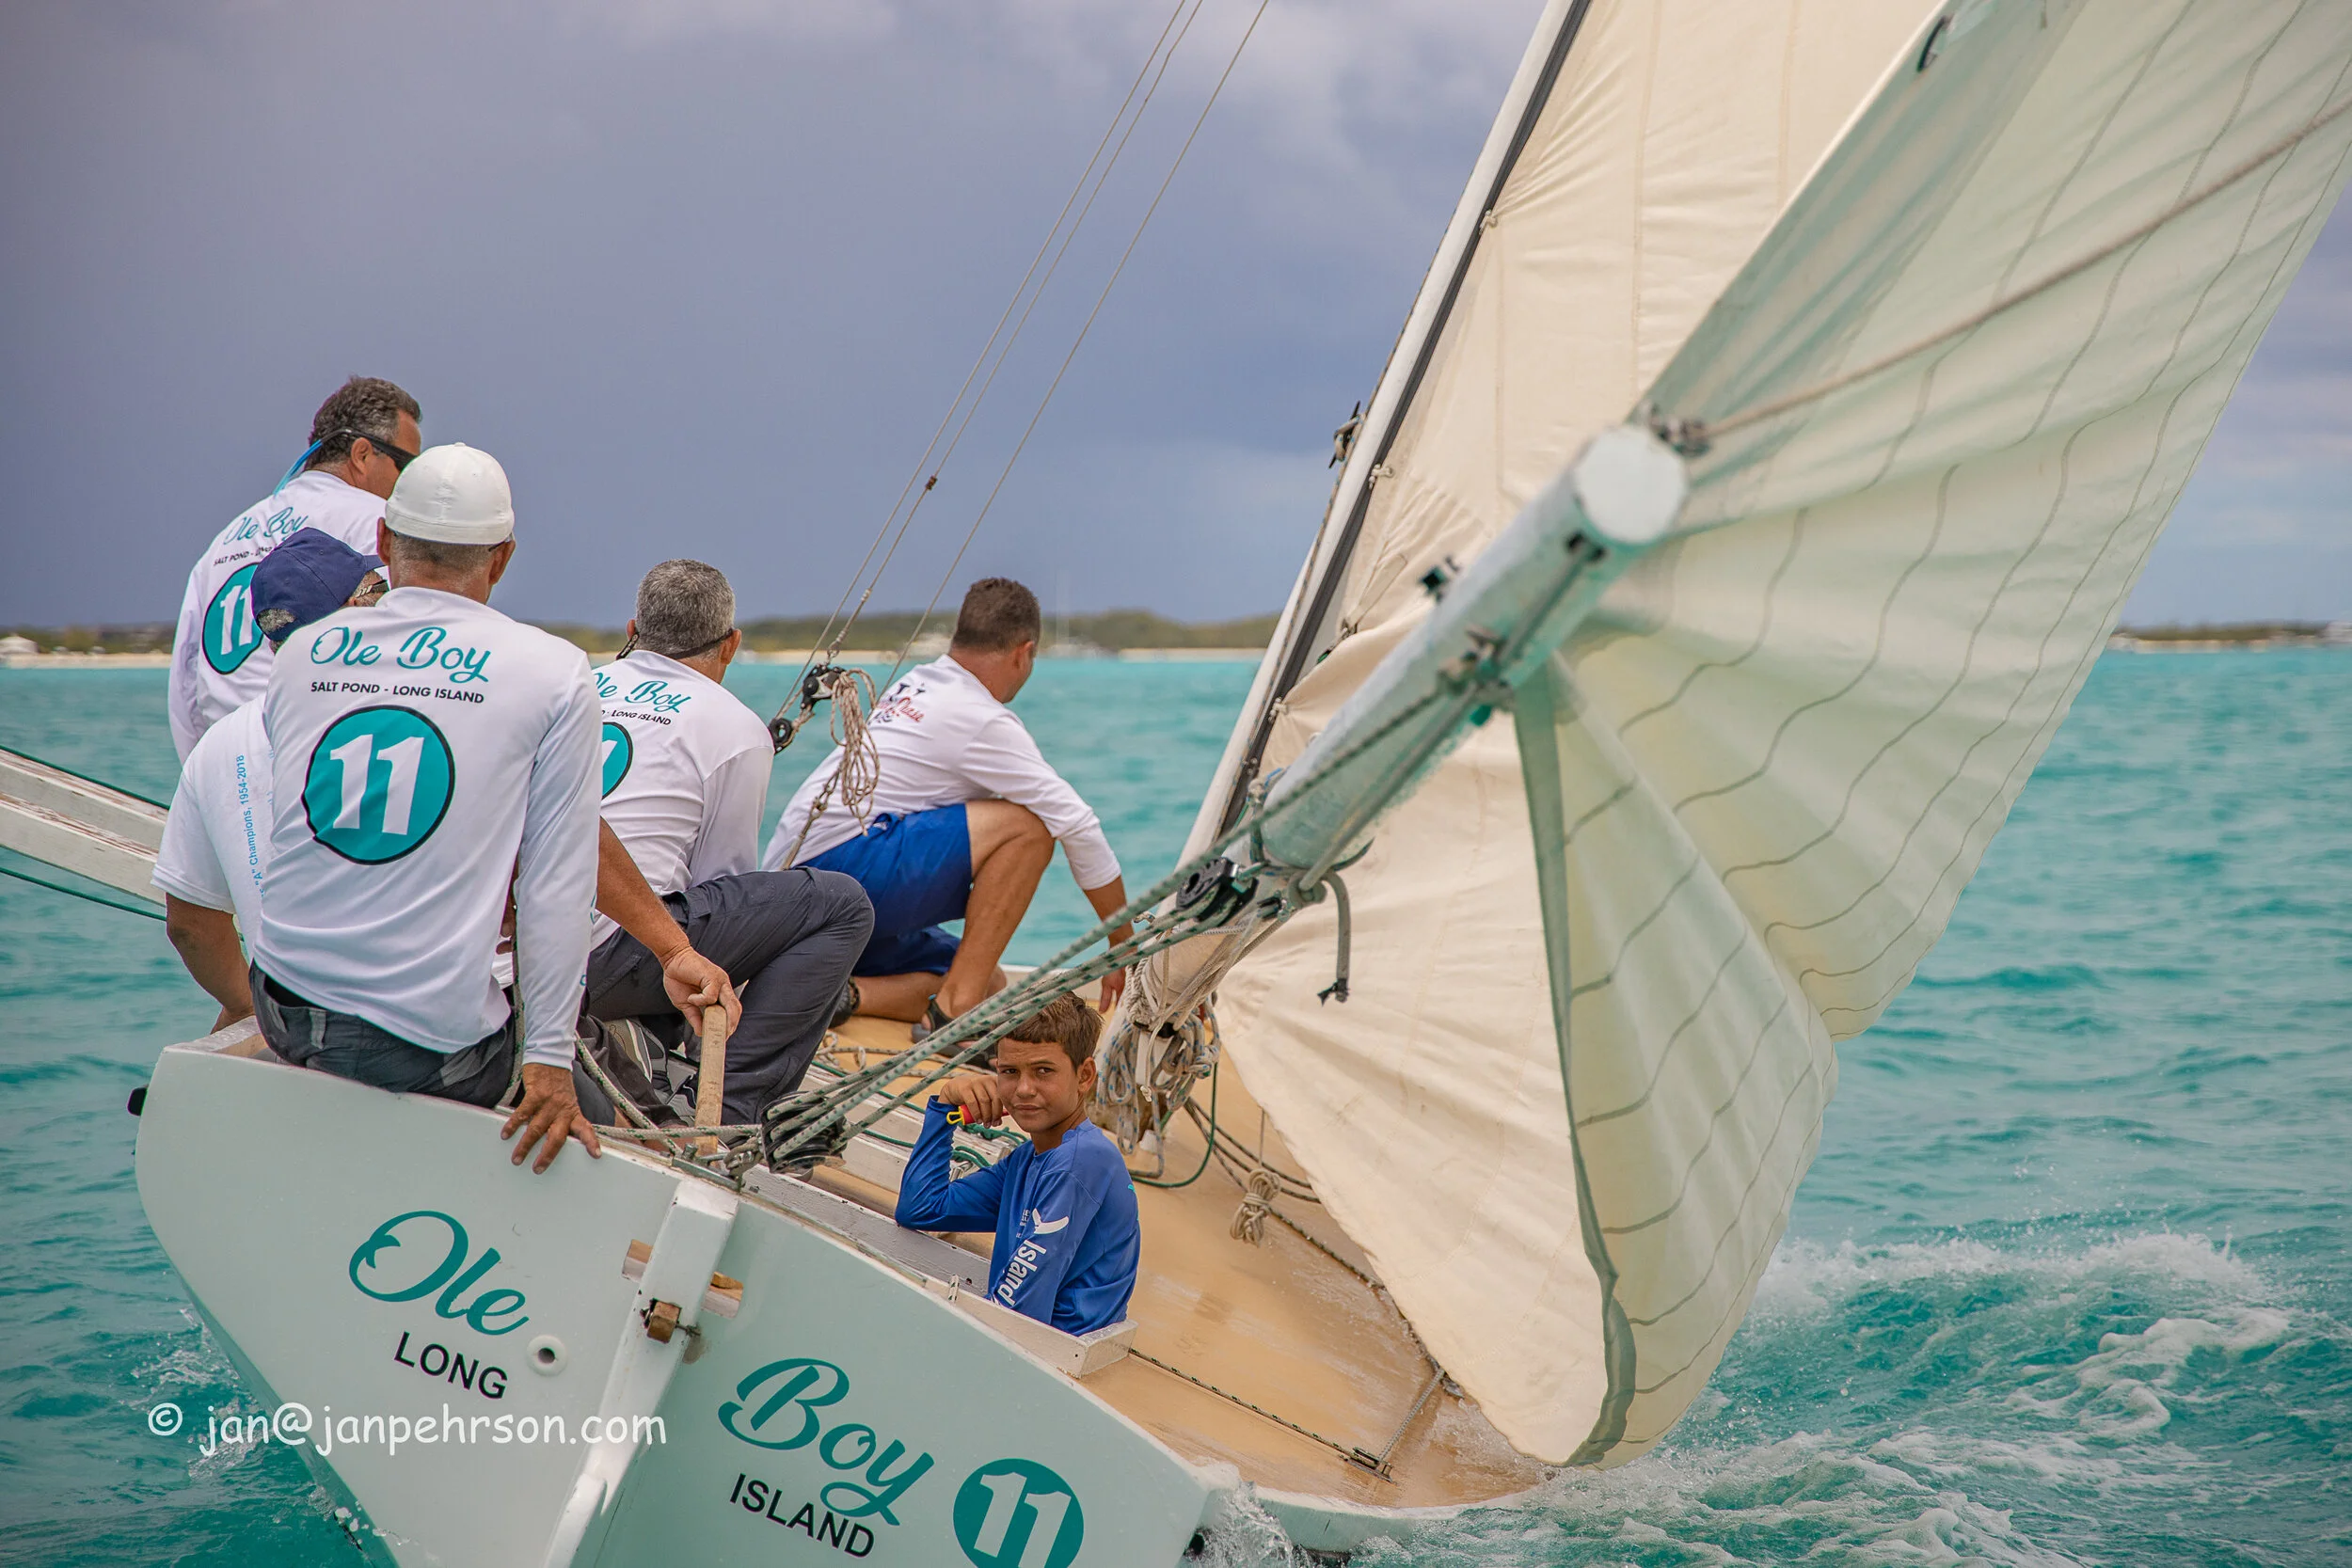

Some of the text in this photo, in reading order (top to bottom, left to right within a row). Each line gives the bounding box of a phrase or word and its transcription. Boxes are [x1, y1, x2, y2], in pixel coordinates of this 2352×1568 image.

[223, 506, 309, 545] Ole Boy
[229, 550, 249, 562] POND
[220, 585, 252, 655] 11
[310, 626, 491, 684] Ole Boy
[310, 681, 339, 692] SALT
[341, 682, 380, 693] POND
[392, 685, 431, 697] LONG
[435, 688, 485, 704] ISLAND
[612, 709, 638, 719] LONG
[638, 713, 672, 725] ISLAND
[625, 680, 691, 713] Boy
[236, 754, 249, 805] 1954-2018
[329, 734, 424, 835] 11
[243, 806, 258, 865] Champions,
[251, 869, 263, 886] "A"
[997, 1240, 1046, 1306] Island
[349, 1211, 934, 1526] Ole Boy
[393, 1331, 875, 1559] LONG ISLAND
[973, 1471, 1073, 1568] 11
